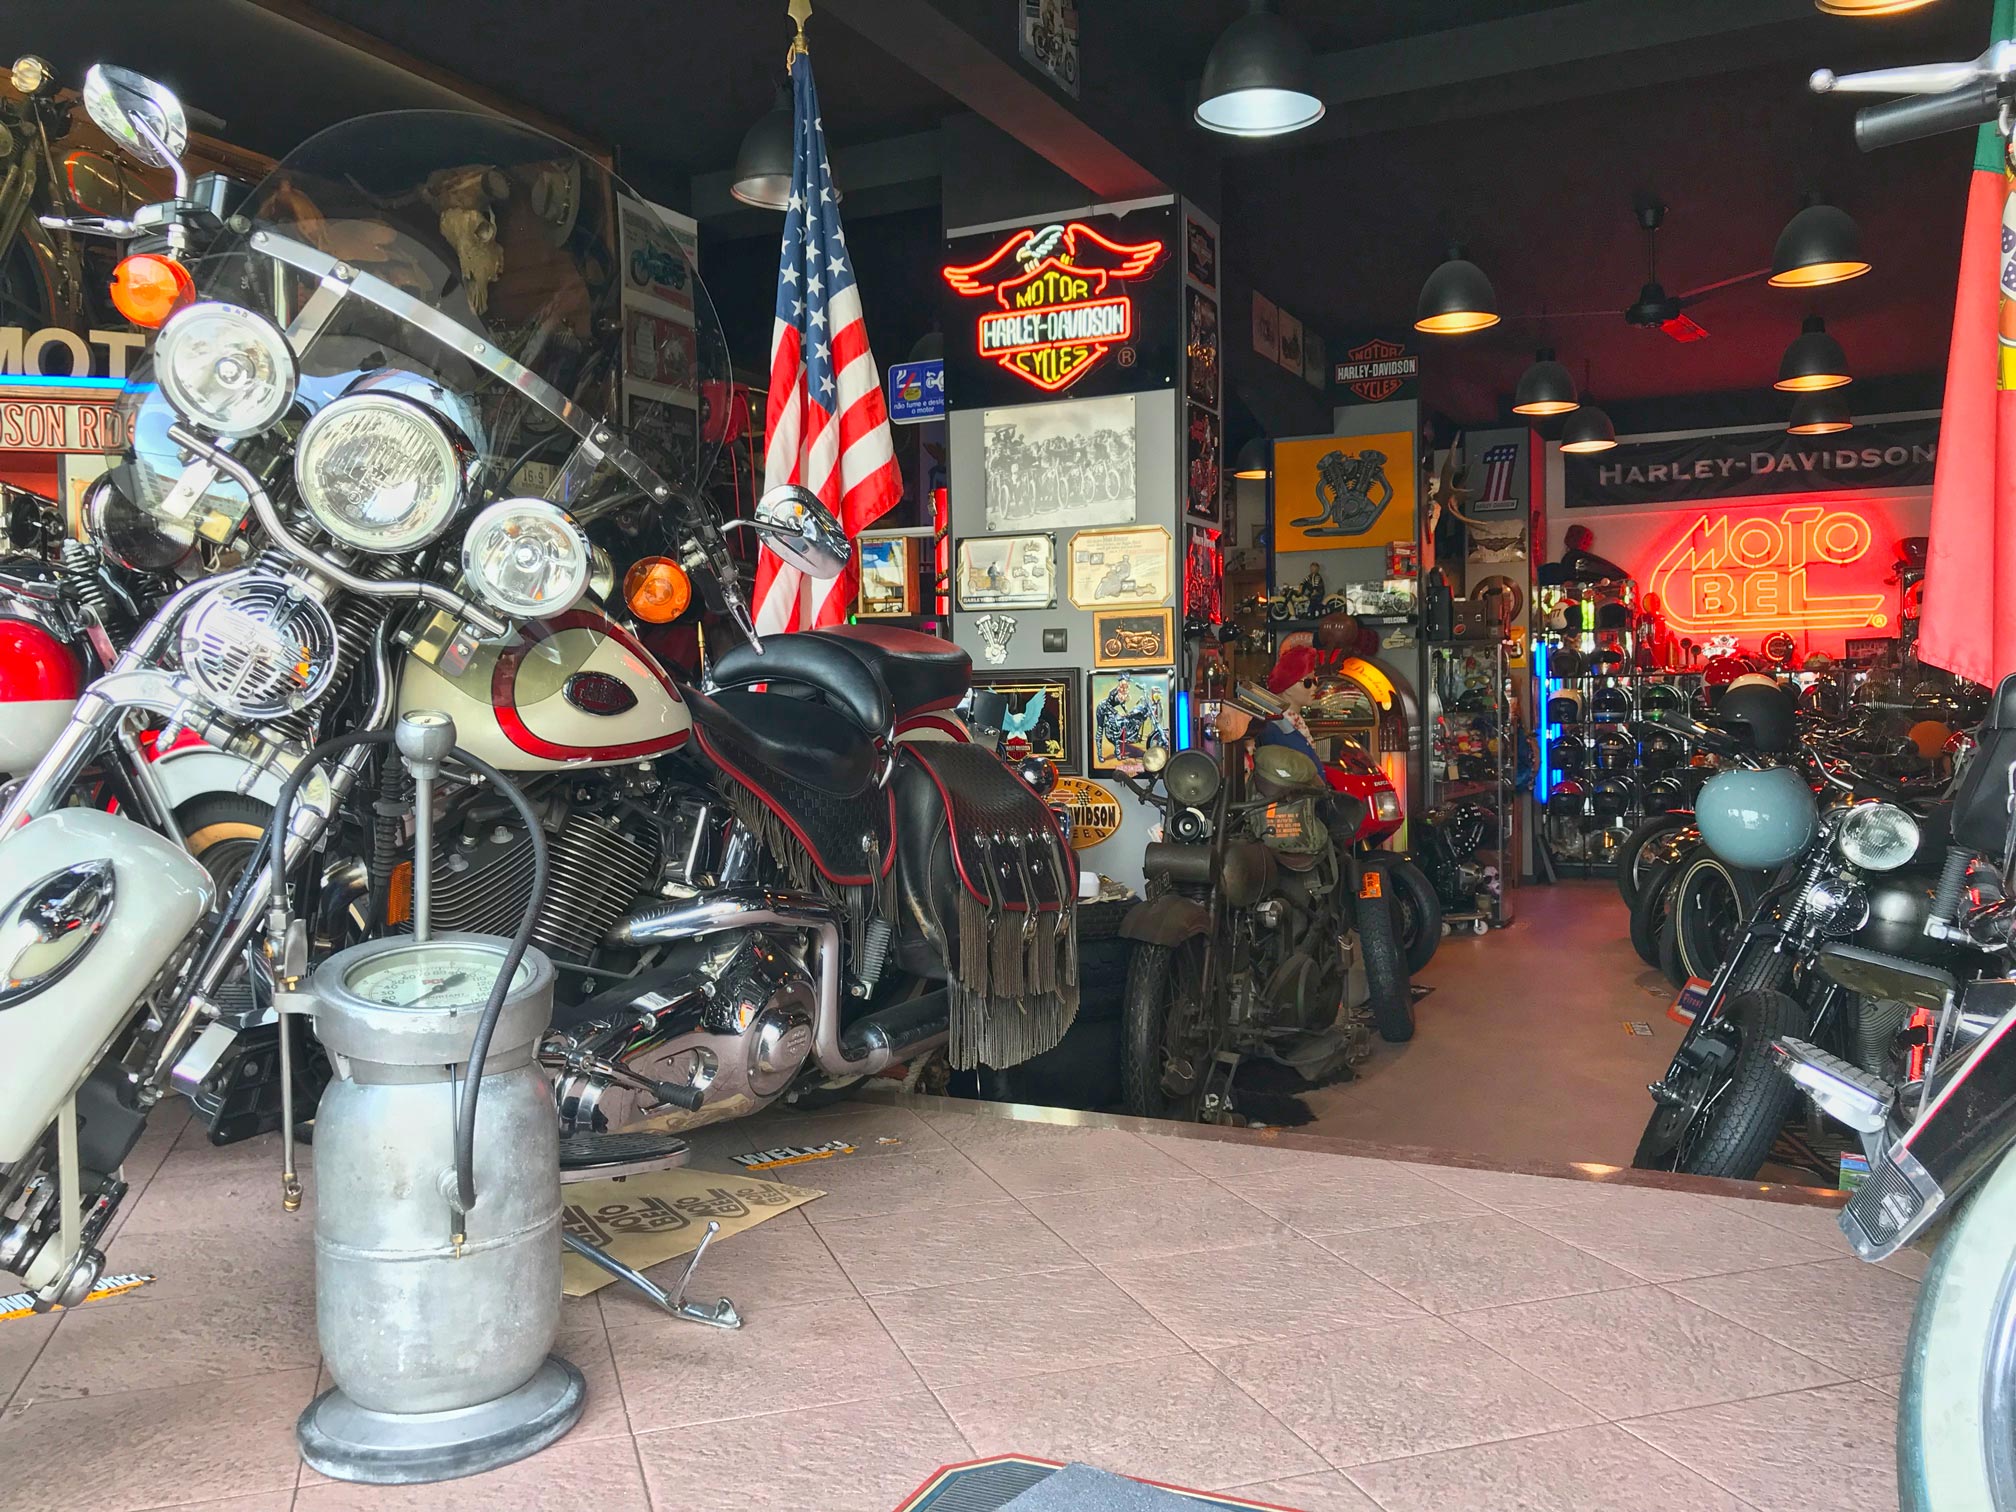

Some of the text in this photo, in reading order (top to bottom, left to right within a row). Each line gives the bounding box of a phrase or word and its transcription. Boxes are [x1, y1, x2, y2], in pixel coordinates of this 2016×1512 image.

[1016, 271, 1089, 309] MOTOR
[983, 303, 1125, 349] HARLEY-DAVIDSON
[1016, 345, 1089, 382] CYCLES
[1354, 343, 1399, 361] MOTOR
[1337, 359, 1416, 381] HARLEY-DAVIDSON
[1355, 379, 1398, 399] CYCLES
[906, 400, 921, 408] fume
[0, 404, 123, 448] SON RD
[1688, 507, 1873, 573] MOTO
[1691, 567, 1886, 619] BEL
[1383, 616, 1408, 624] WELCOME
[1063, 780, 1103, 797] NEED
[1072, 828, 1107, 838] EED
[637, 1197, 675, 1229] BEL
